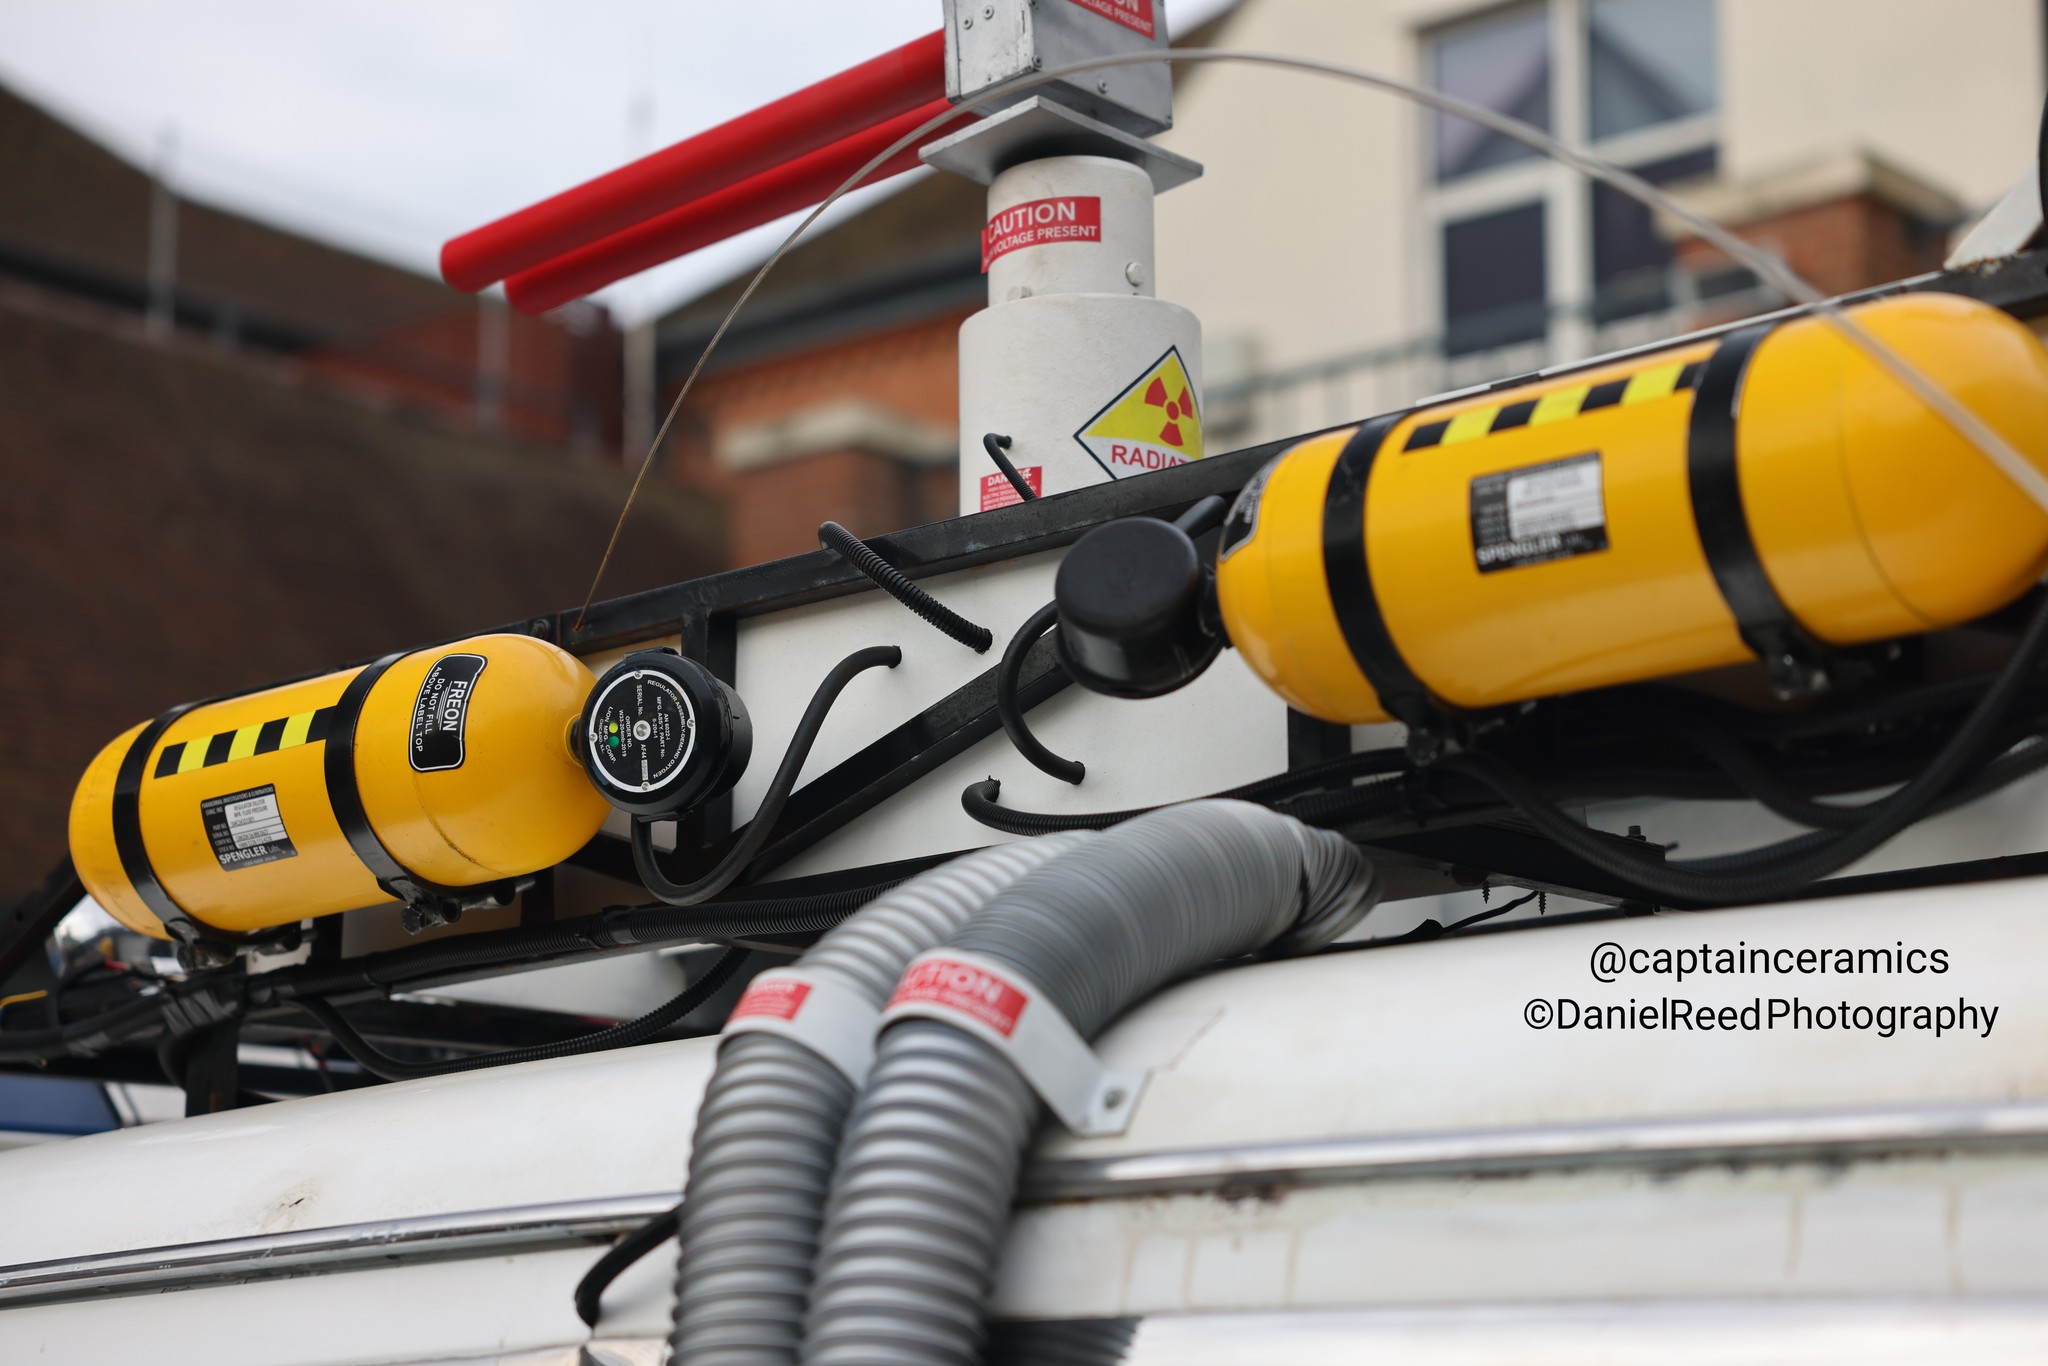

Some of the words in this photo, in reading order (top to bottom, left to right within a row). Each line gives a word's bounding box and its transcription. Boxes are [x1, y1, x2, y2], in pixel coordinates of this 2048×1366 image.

[1037, 225, 1097, 240] PRESENT
[423, 666, 442, 695] ABOVE
[434, 678, 445, 690] DO
[647, 679, 678, 702] REGULATOR
[428, 692, 439, 711] NOT
[442, 680, 468, 731] FREON
[416, 697, 428, 729] LABEL
[604, 706, 614, 722] LION
[425, 714, 434, 735] FILL
[415, 731, 424, 752] TOP
[605, 744, 617, 764] CORP.
[652, 759, 676, 779] OXYGEN
[219, 845, 268, 865] SPENGLER
